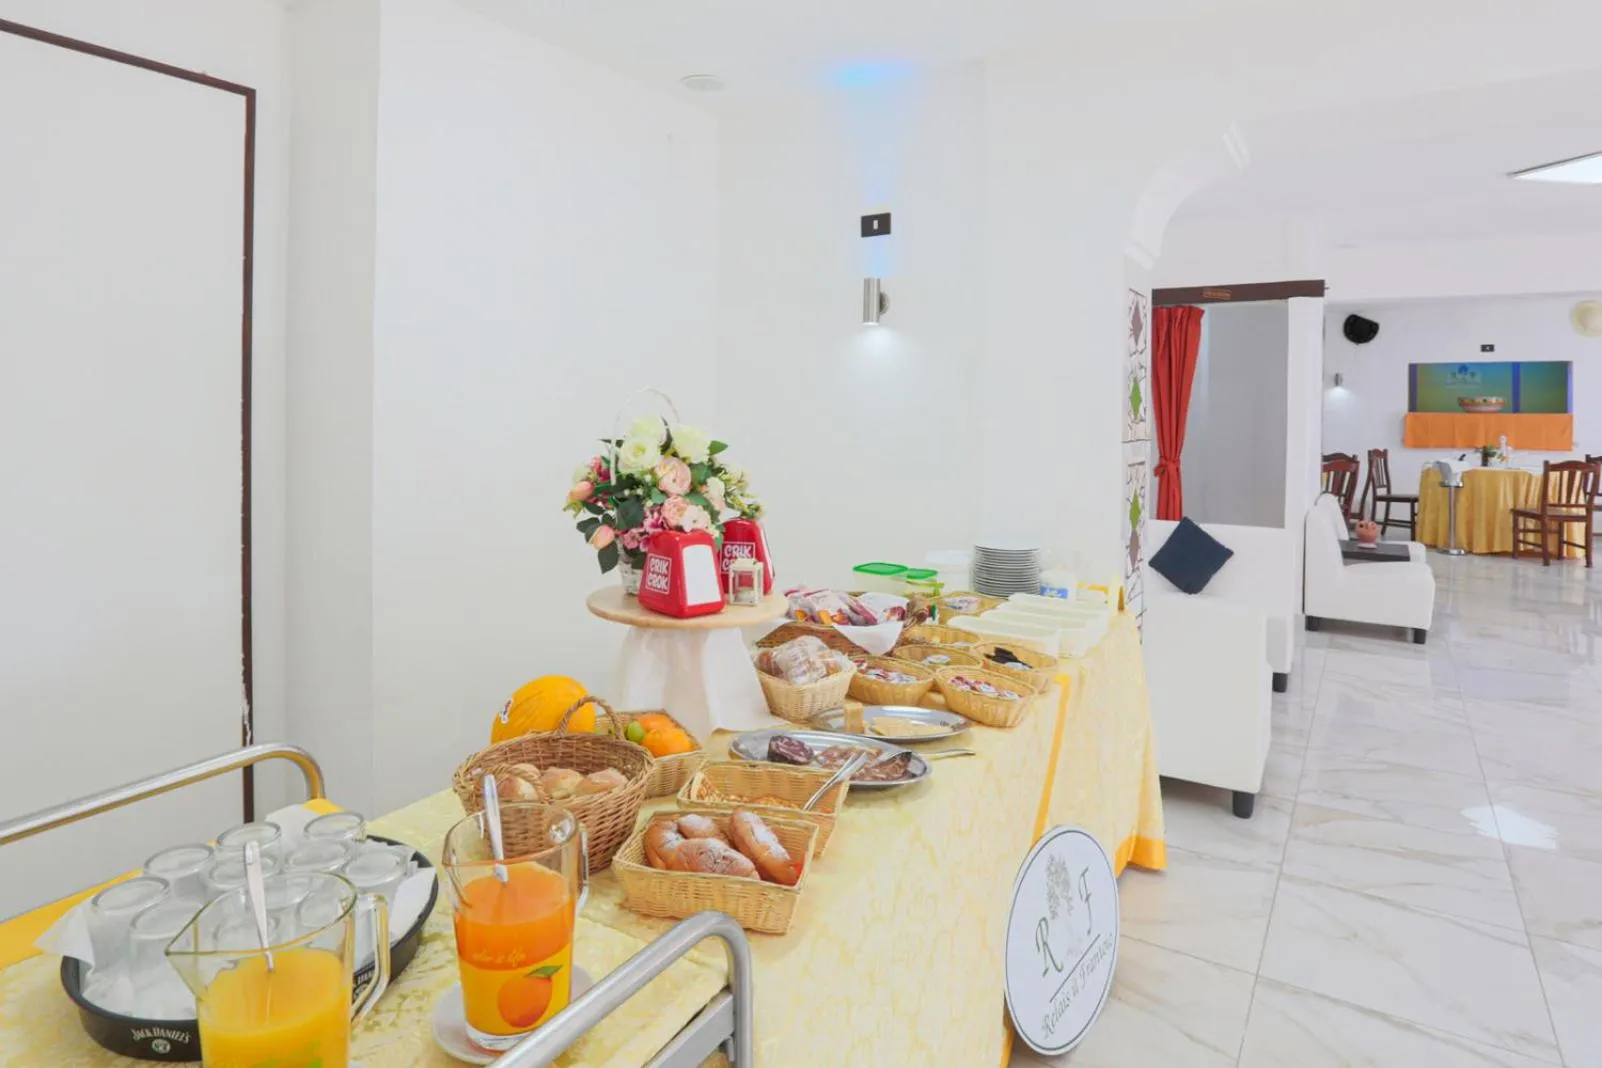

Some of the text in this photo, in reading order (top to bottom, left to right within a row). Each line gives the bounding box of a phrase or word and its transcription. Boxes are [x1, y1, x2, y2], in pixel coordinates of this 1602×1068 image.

[724, 544, 752, 559] CRIK
[650, 557, 669, 575] CRIK
[647, 573, 668, 591] CROK
[1035, 916, 1064, 978] R
